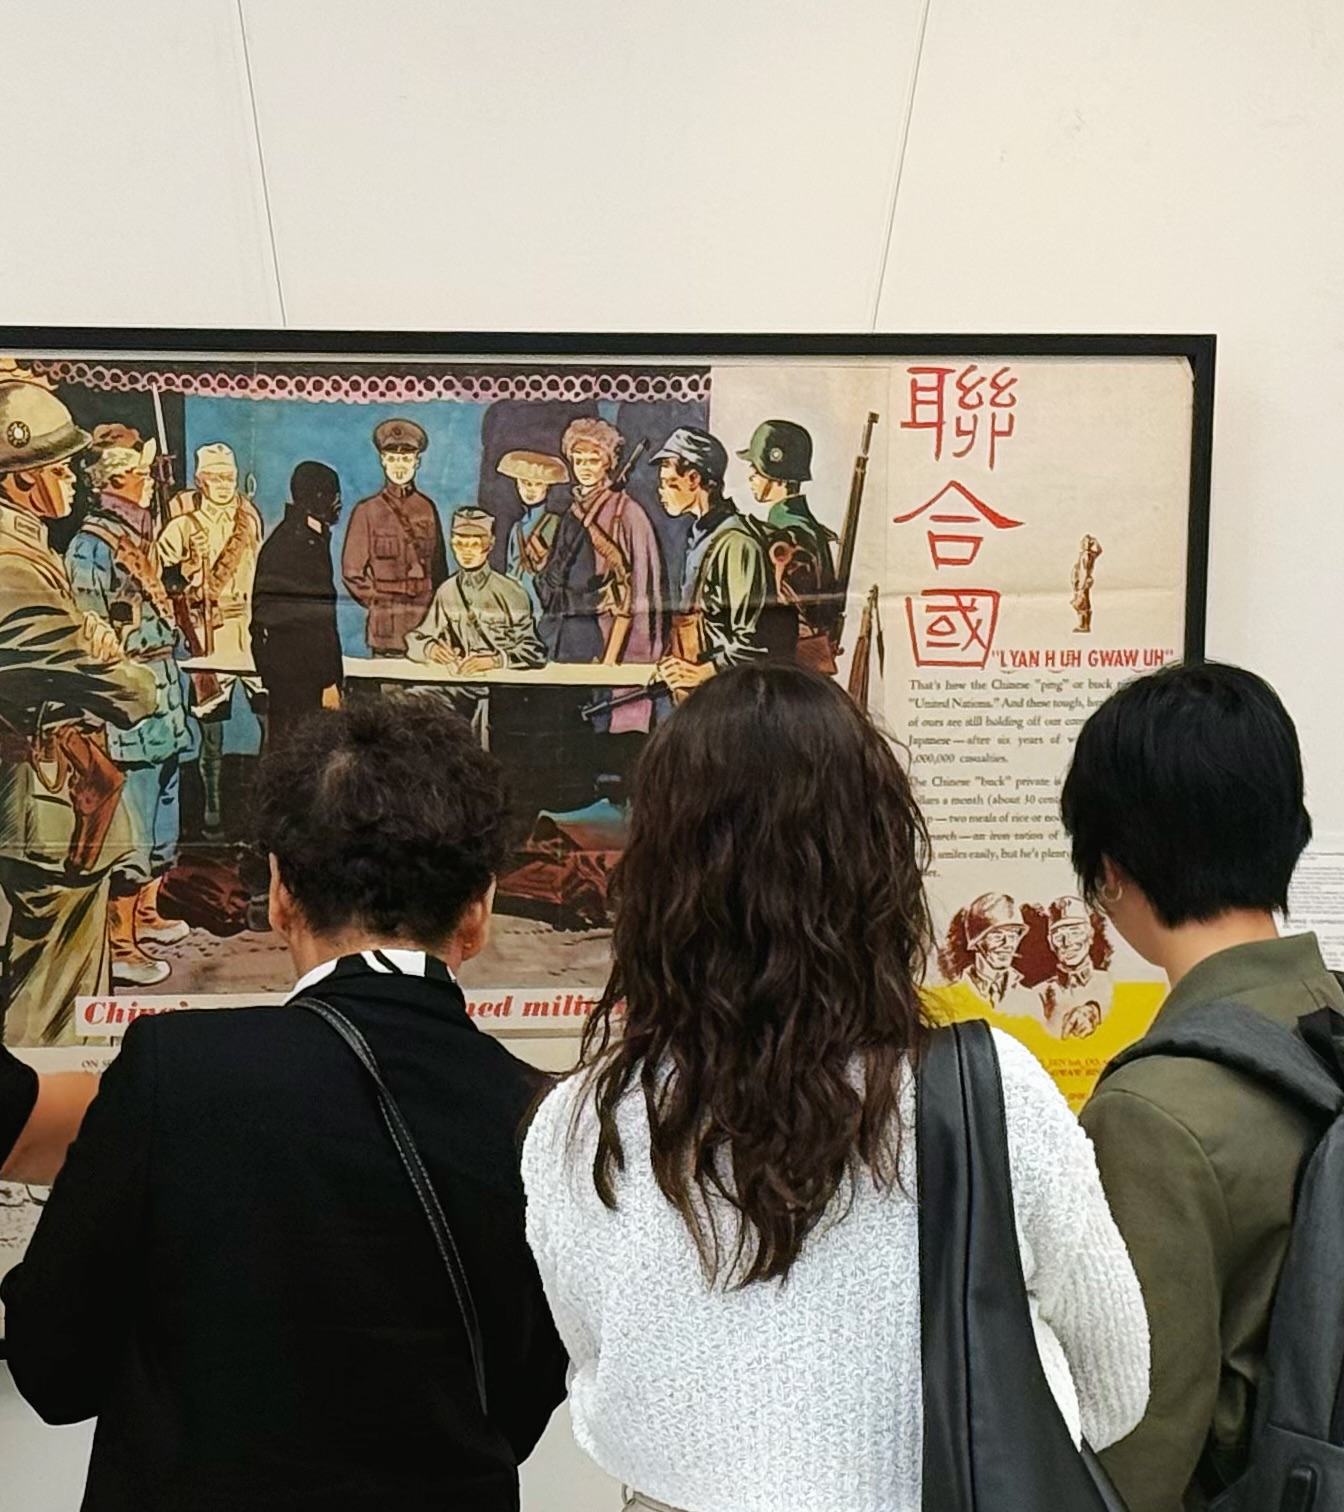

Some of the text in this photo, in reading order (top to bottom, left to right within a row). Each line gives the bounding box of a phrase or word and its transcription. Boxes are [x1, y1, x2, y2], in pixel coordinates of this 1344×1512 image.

[893, 364, 1025, 669] 聯合國
[908, 679, 941, 690] That's
[945, 680, 966, 690] how
[970, 680, 987, 690] the
[991, 679, 1030, 690] Chinese
[1088, 678, 1113, 690] buck
[908, 697, 950, 709] "United
[1001, 698, 1025, 709] And
[1026, 698, 1051, 708] these
[908, 717, 919, 727] of
[921, 719, 944, 727] ours
[947, 719, 962, 727] are
[965, 716, 983, 727] still
[985, 716, 1024, 730] holding
[1026, 716, 1041, 727] off
[997, 735, 1010, 745] six
[1018, 737, 1044, 747] years
[1049, 734, 1061, 745] of
[959, 753, 1009, 763] casualties.
[931, 776, 972, 787] Chinese
[975, 775, 1012, 787] "buck"
[1016, 776, 1051, 790] private
[951, 794, 984, 805] month
[968, 812, 997, 823] meals
[999, 812, 1009, 823] of
[990, 830, 1011, 841] iron
[1015, 830, 1044, 841] ration
[1048, 829, 1060, 841] of
[938, 849, 967, 860] smiles
[969, 849, 1000, 862] easily,
[1001, 849, 1018, 859] but
[1020, 849, 1039, 859] he's
